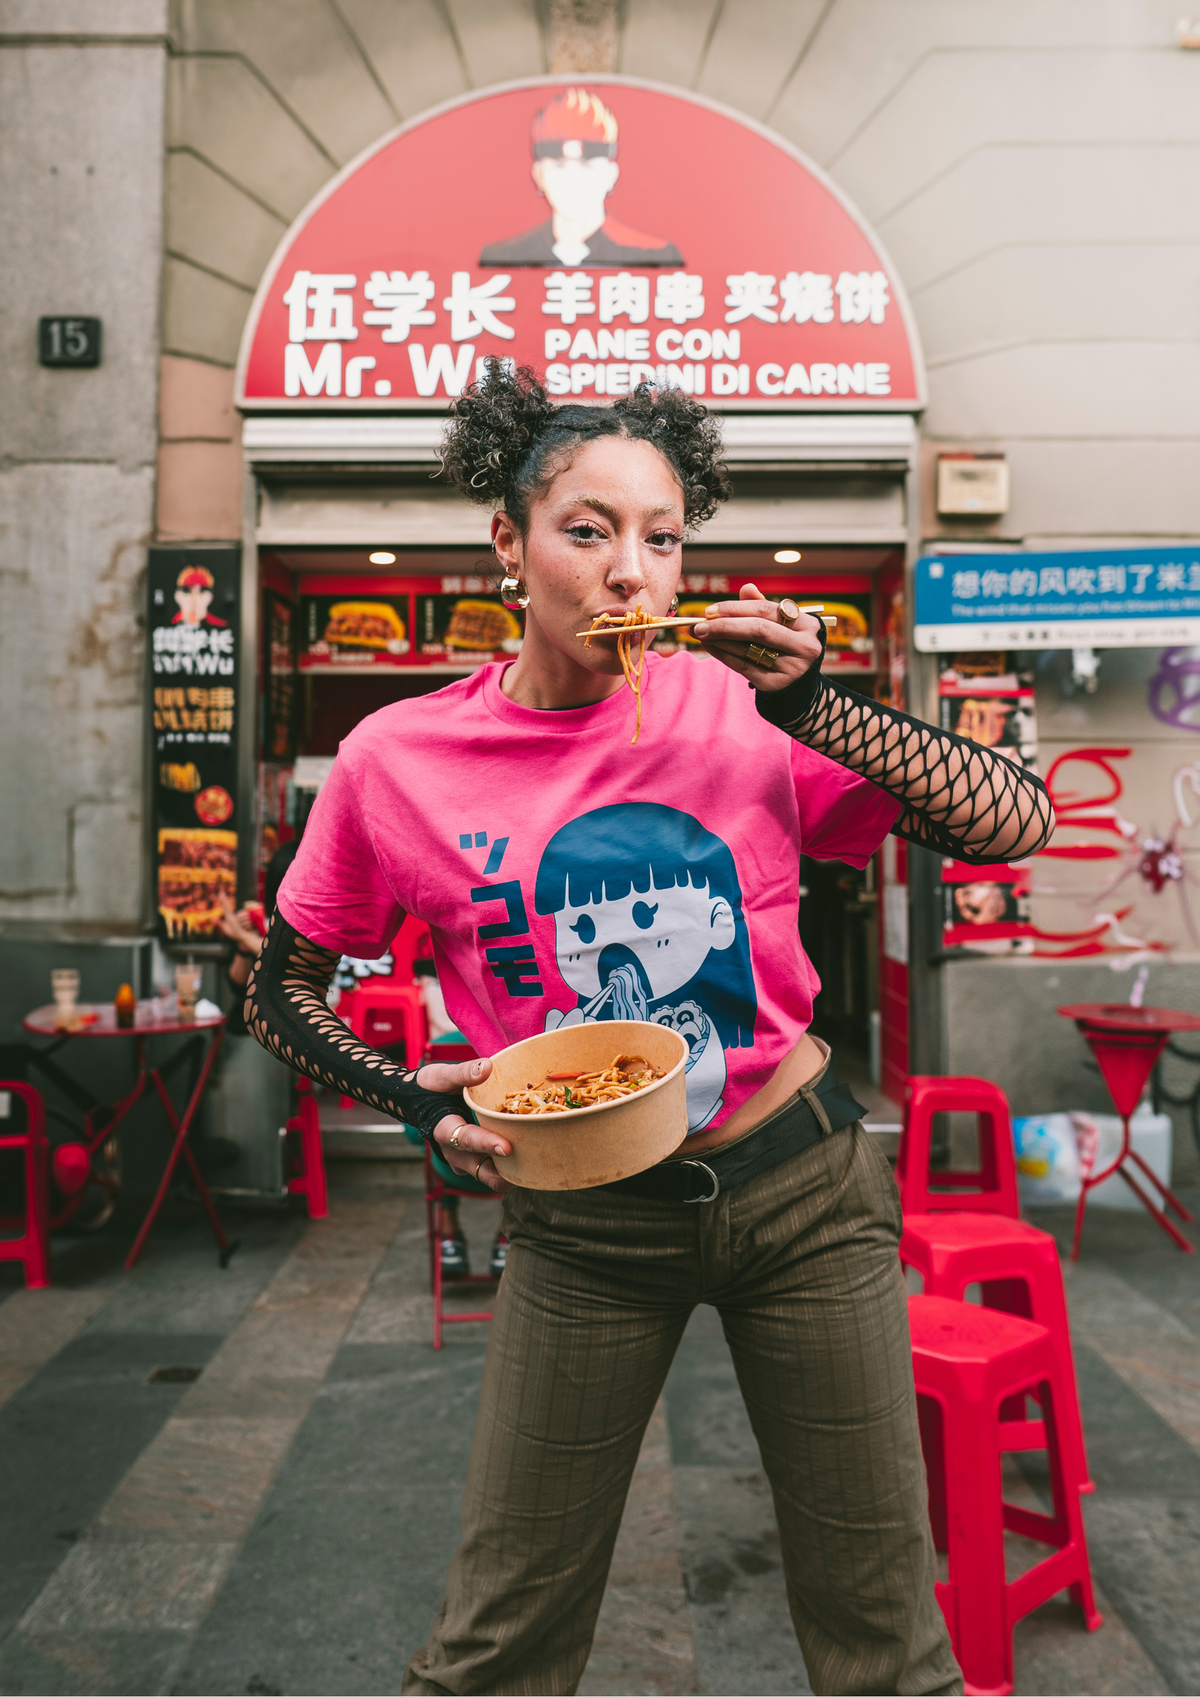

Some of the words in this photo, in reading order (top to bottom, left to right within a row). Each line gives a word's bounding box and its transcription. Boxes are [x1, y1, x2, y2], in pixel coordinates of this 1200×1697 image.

[283, 270, 516, 343] 伍学长
[541, 271, 705, 325] 羊肉串
[724, 271, 890, 324] 夹烧饼
[49, 321, 88, 357] 15
[544, 328, 650, 361] PANE
[655, 328, 741, 361] CON
[284, 342, 391, 397] Mr.
[711, 363, 750, 395] DI
[755, 362, 891, 396] CARNE
